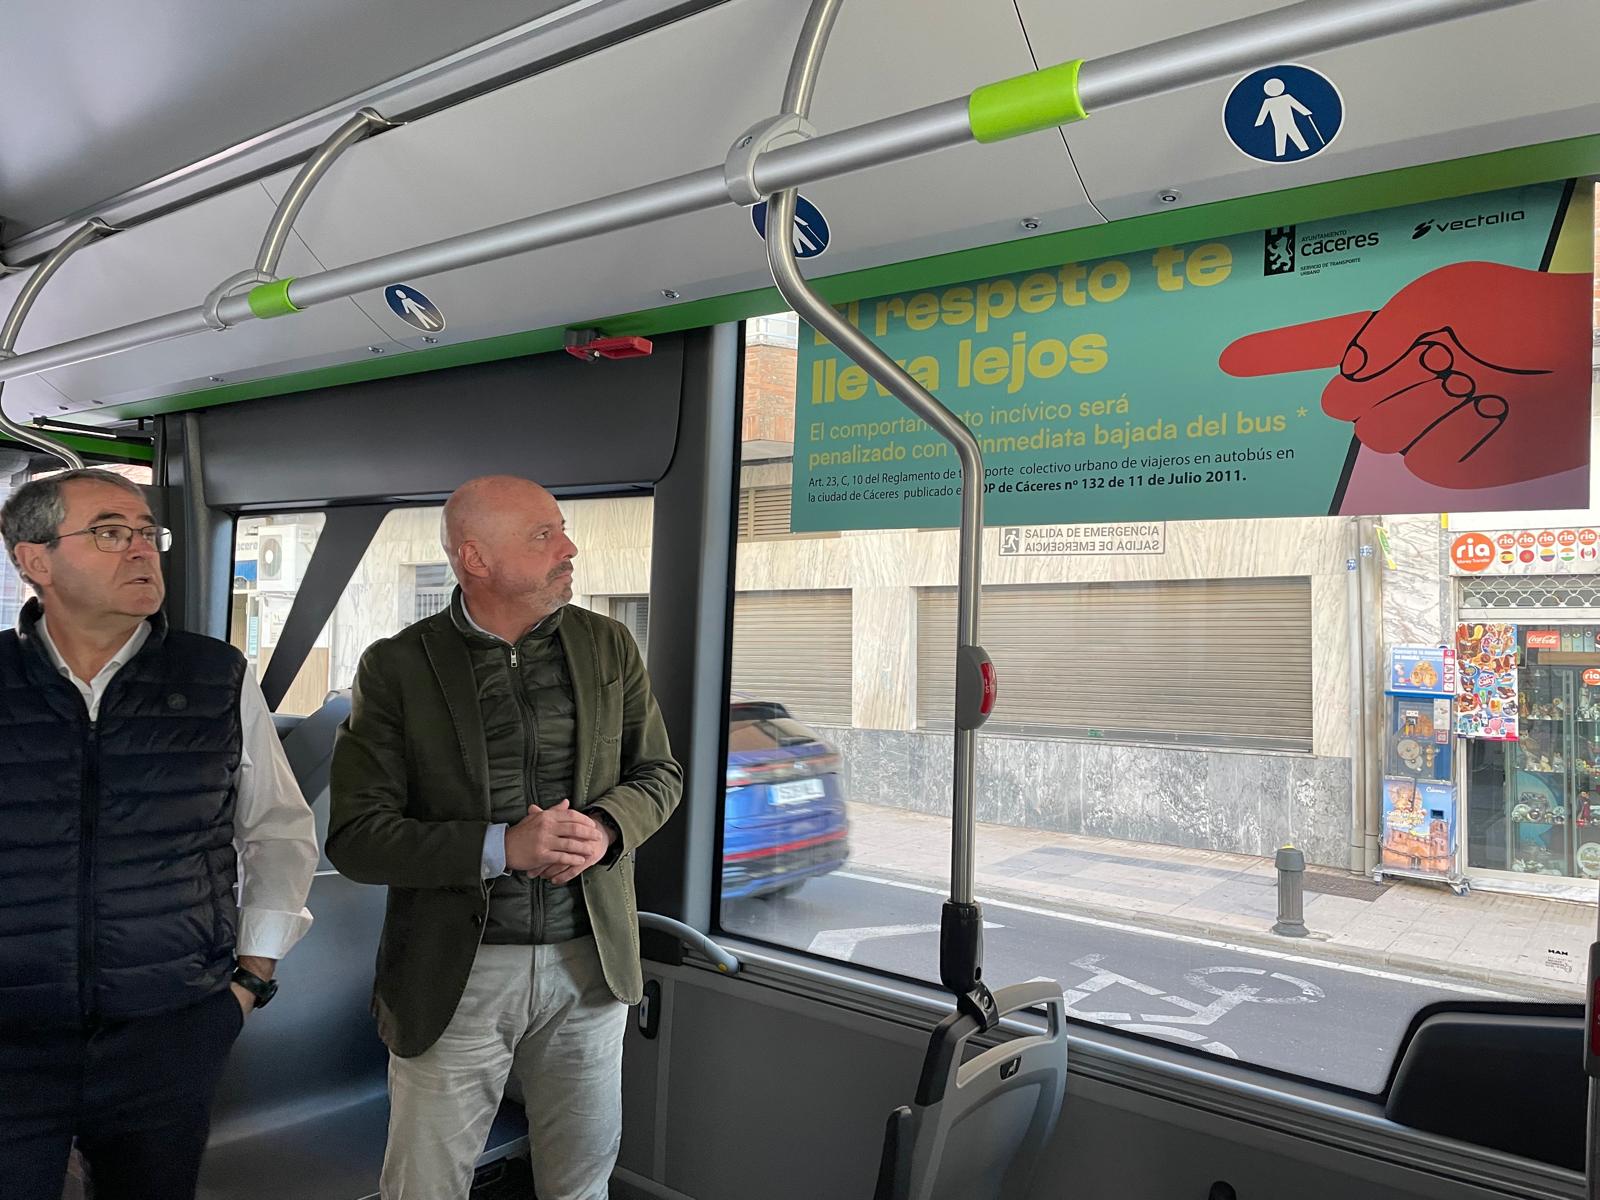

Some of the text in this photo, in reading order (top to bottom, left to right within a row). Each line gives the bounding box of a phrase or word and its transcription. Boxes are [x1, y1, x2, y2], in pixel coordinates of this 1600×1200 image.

[1436, 210, 1525, 232] vectalia
[1301, 229, 1348, 242] AYUNTAMIENTO
[1300, 262, 1321, 271] SERVICIO
[1329, 257, 1361, 267] TRANSPORTE
[876, 258, 1131, 337] respeto
[1152, 243, 1233, 292] te
[957, 331, 1109, 394] lejos
[811, 422, 825, 441] El
[990, 402, 1073, 425] incívico
[1079, 392, 1130, 417] será
[808, 440, 906, 472] penalizado
[912, 442, 947, 459] con
[1095, 418, 1177, 450] bajada
[1186, 412, 1228, 439] del
[1237, 411, 1287, 435] bus
[808, 476, 824, 488] Art.
[826, 476, 839, 488] 23,
[841, 475, 850, 487] C,
[853, 475, 863, 485] 10
[865, 472, 880, 485] del
[882, 469, 940, 486] Reglamento
[943, 468, 955, 479] de
[1020, 462, 1071, 475] colectivo
[1074, 459, 1118, 472] urbano
[1121, 456, 1137, 469] de
[1141, 453, 1190, 470] viajeros
[1194, 453, 1211, 464] en
[1215, 447, 1272, 463] autobús
[1277, 448, 1294, 460] en
[808, 492, 815, 502] la
[818, 490, 847, 502] ciudad
[849, 490, 860, 501] de
[863, 488, 899, 501] Cáceres
[903, 484, 953, 501] publicado
[998, 481, 1013, 493] de
[1015, 480, 1061, 493] Cáceres
[1082, 477, 1105, 489] 132
[1108, 476, 1125, 488] de
[1129, 475, 1143, 487] 11
[1148, 473, 1165, 486] de
[1168, 472, 1202, 485] Julio
[1205, 470, 1247, 484] 2011.
[1025, 525, 1160, 539] SALIDA DE EMERGENCIA
[1519, 535, 1533, 543] ria
[1539, 534, 1553, 543] ria
[1559, 533, 1574, 541] ria
[1579, 532, 1594, 541] ria
[1499, 536, 1514, 544] ria
[1456, 538, 1490, 558] ria
[1585, 671, 1599, 680] ria
